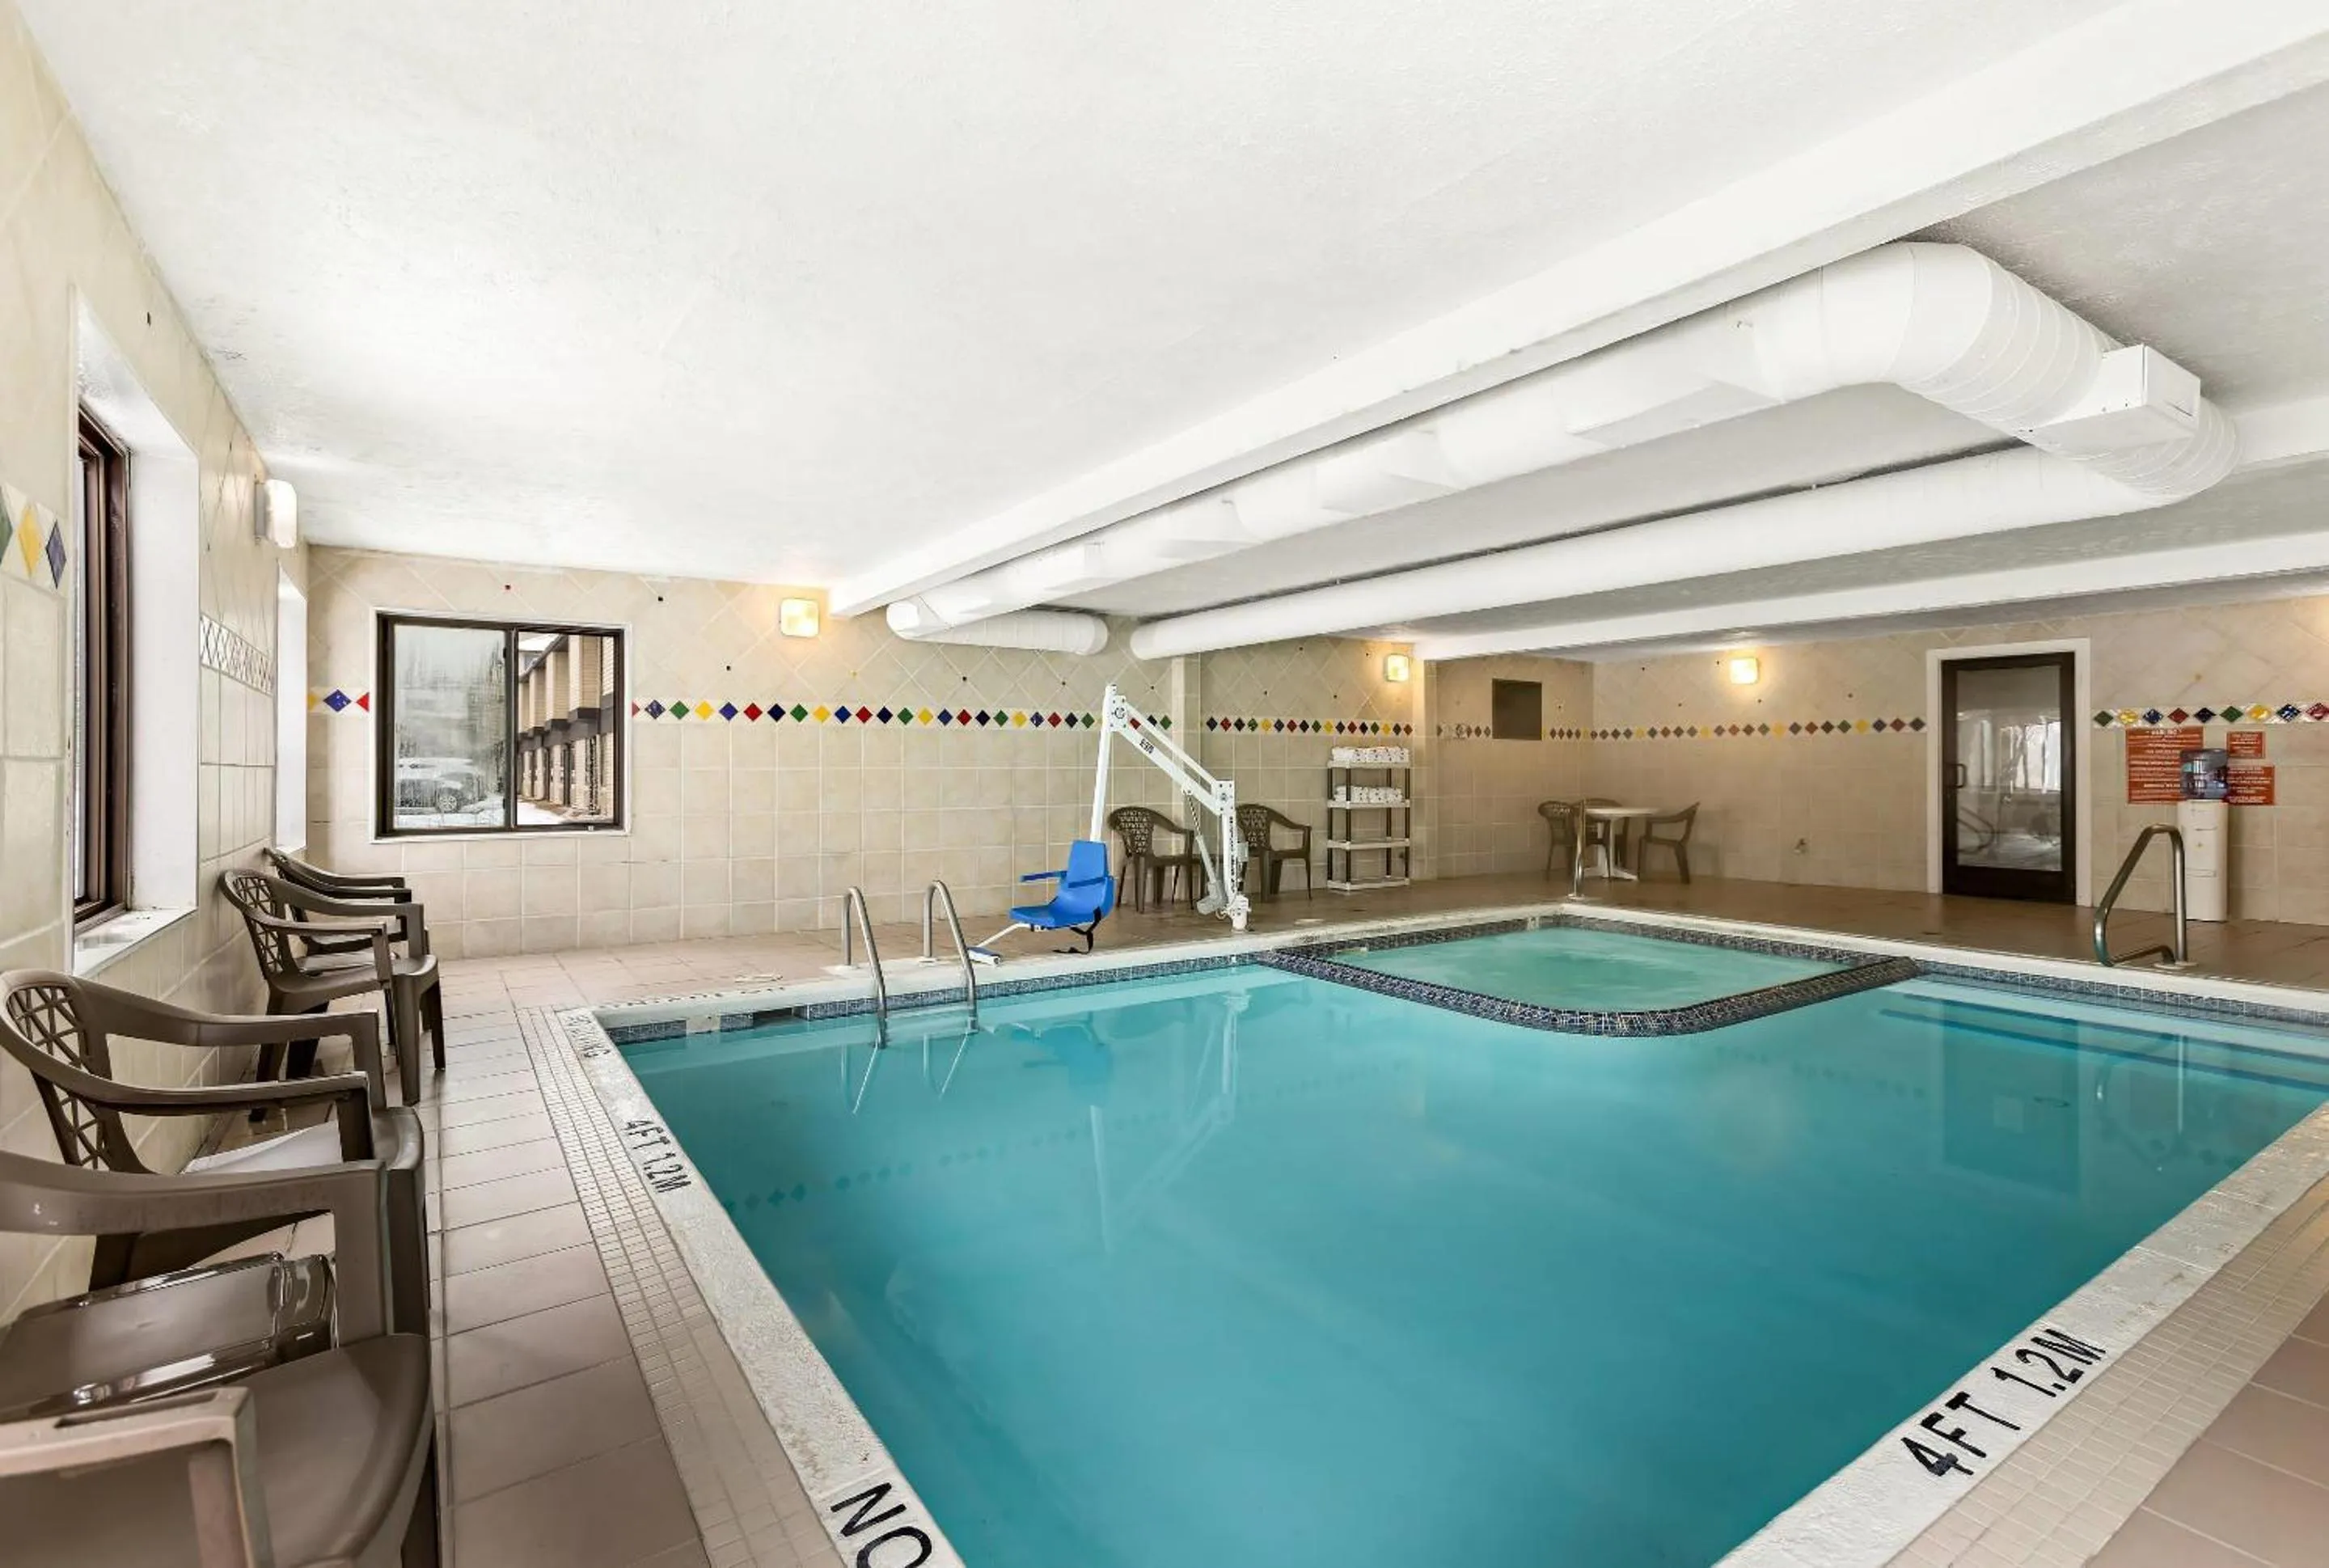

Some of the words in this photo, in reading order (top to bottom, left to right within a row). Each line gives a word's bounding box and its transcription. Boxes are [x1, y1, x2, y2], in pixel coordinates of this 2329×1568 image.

[622, 1120, 670, 1149] 4FT
[1900, 1391, 2022, 1477] 4FT
[1989, 1328, 2107, 1397] 1.2M
[830, 1481, 932, 1568] NO
